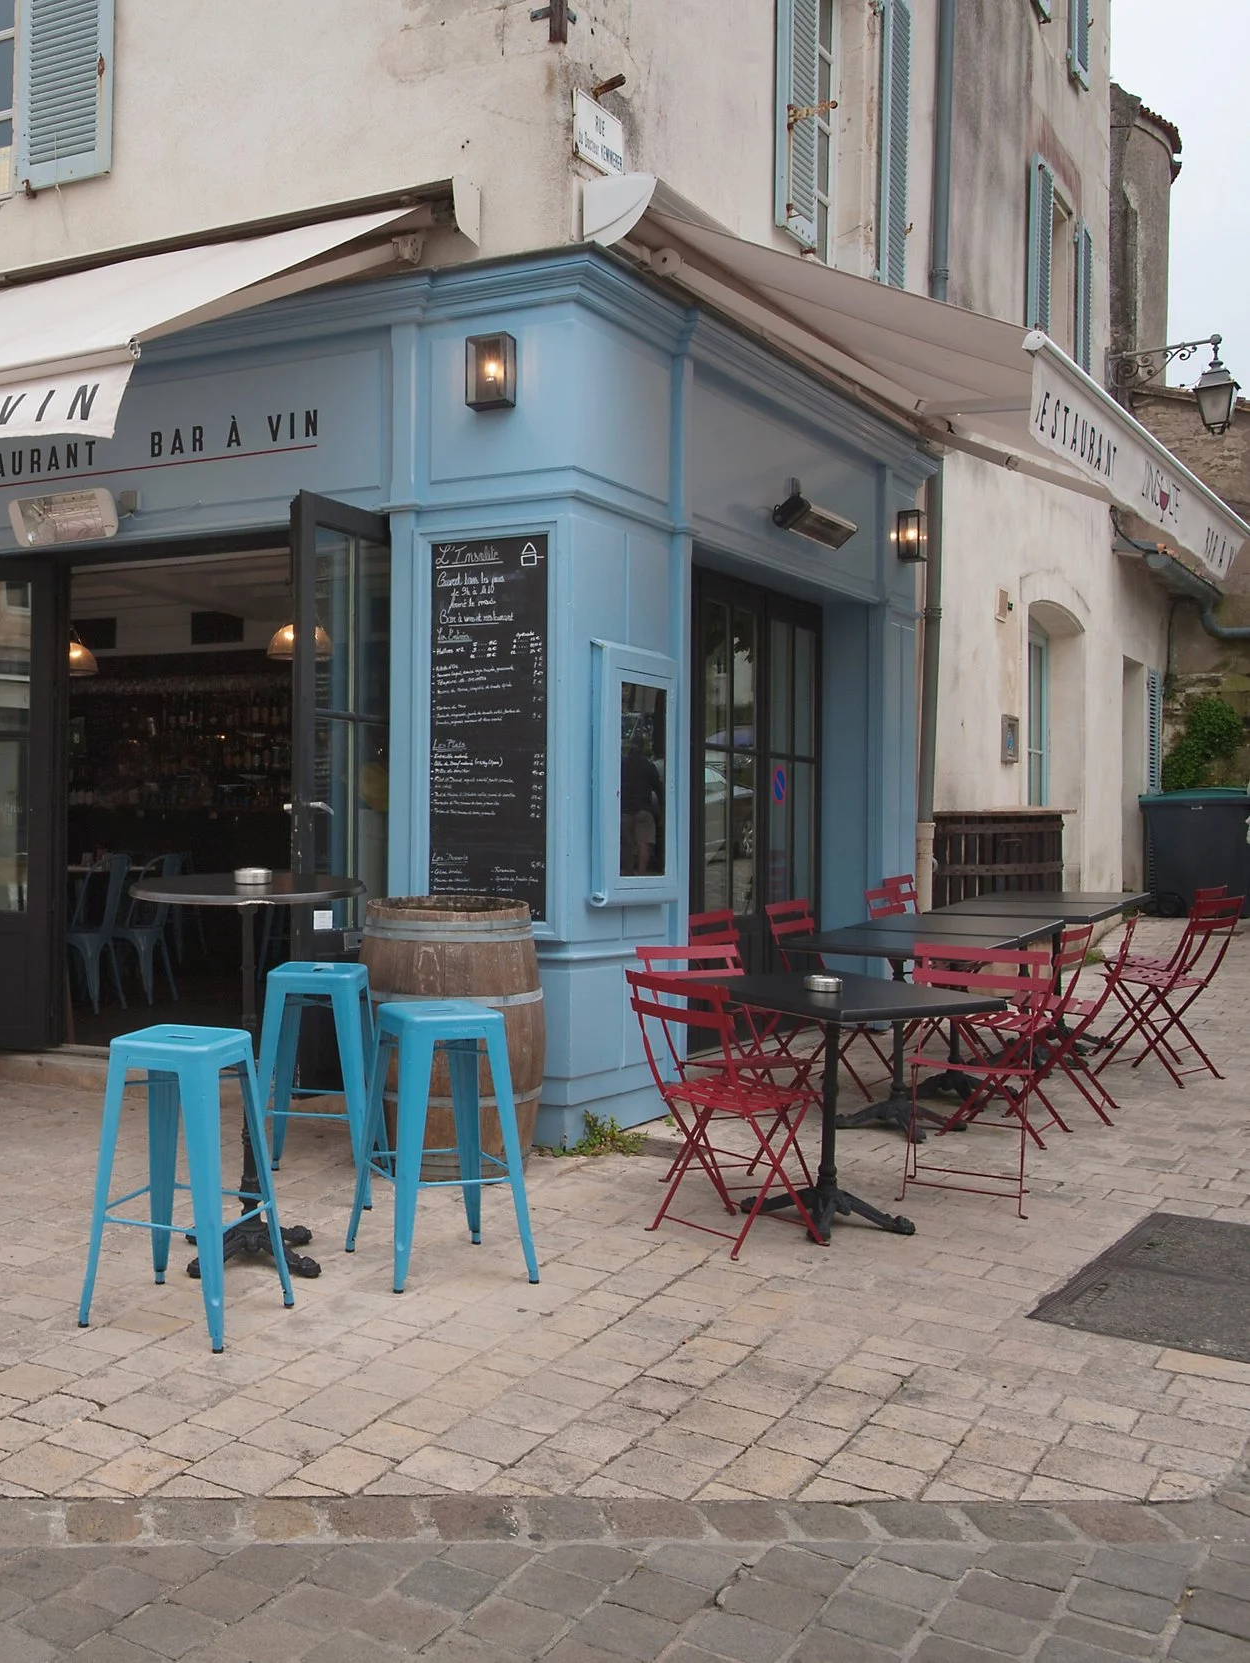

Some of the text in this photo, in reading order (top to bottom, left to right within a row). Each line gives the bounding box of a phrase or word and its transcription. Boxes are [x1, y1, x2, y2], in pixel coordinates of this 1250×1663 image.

[595, 115, 605, 137] RUE
[150, 426, 204, 458] BAR
[226, 415, 242, 448] À
[267, 409, 318, 442] VIN
